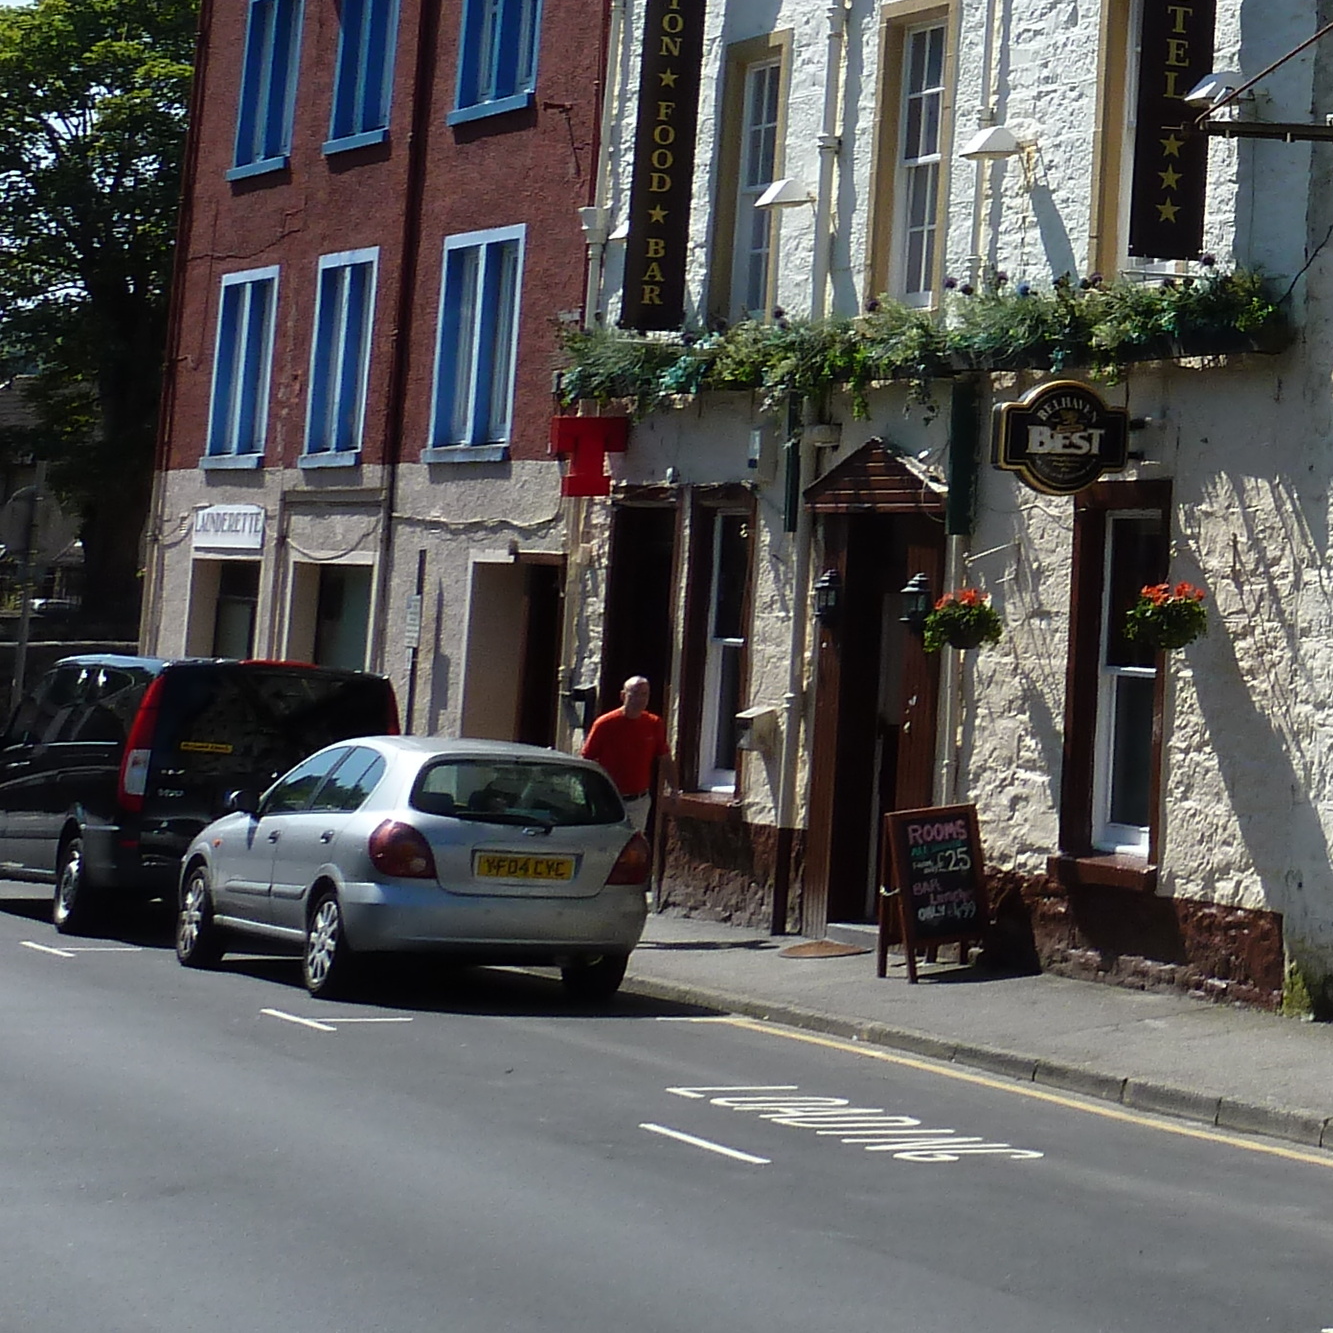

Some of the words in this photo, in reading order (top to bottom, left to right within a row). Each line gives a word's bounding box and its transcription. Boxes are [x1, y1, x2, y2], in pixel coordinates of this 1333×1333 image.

[649, 101, 676, 192] FOOD
[641, 238, 666, 305] BAR
[1036, 396, 1097, 424] BELHAVEN
[1025, 425, 1105, 455] BEST
[195, 511, 262, 533] LAUNDERETTE
[908, 819, 968, 845] ROOMS
[486, 857, 530, 875] YF04
[664, 1084, 1045, 1163] LOADING
